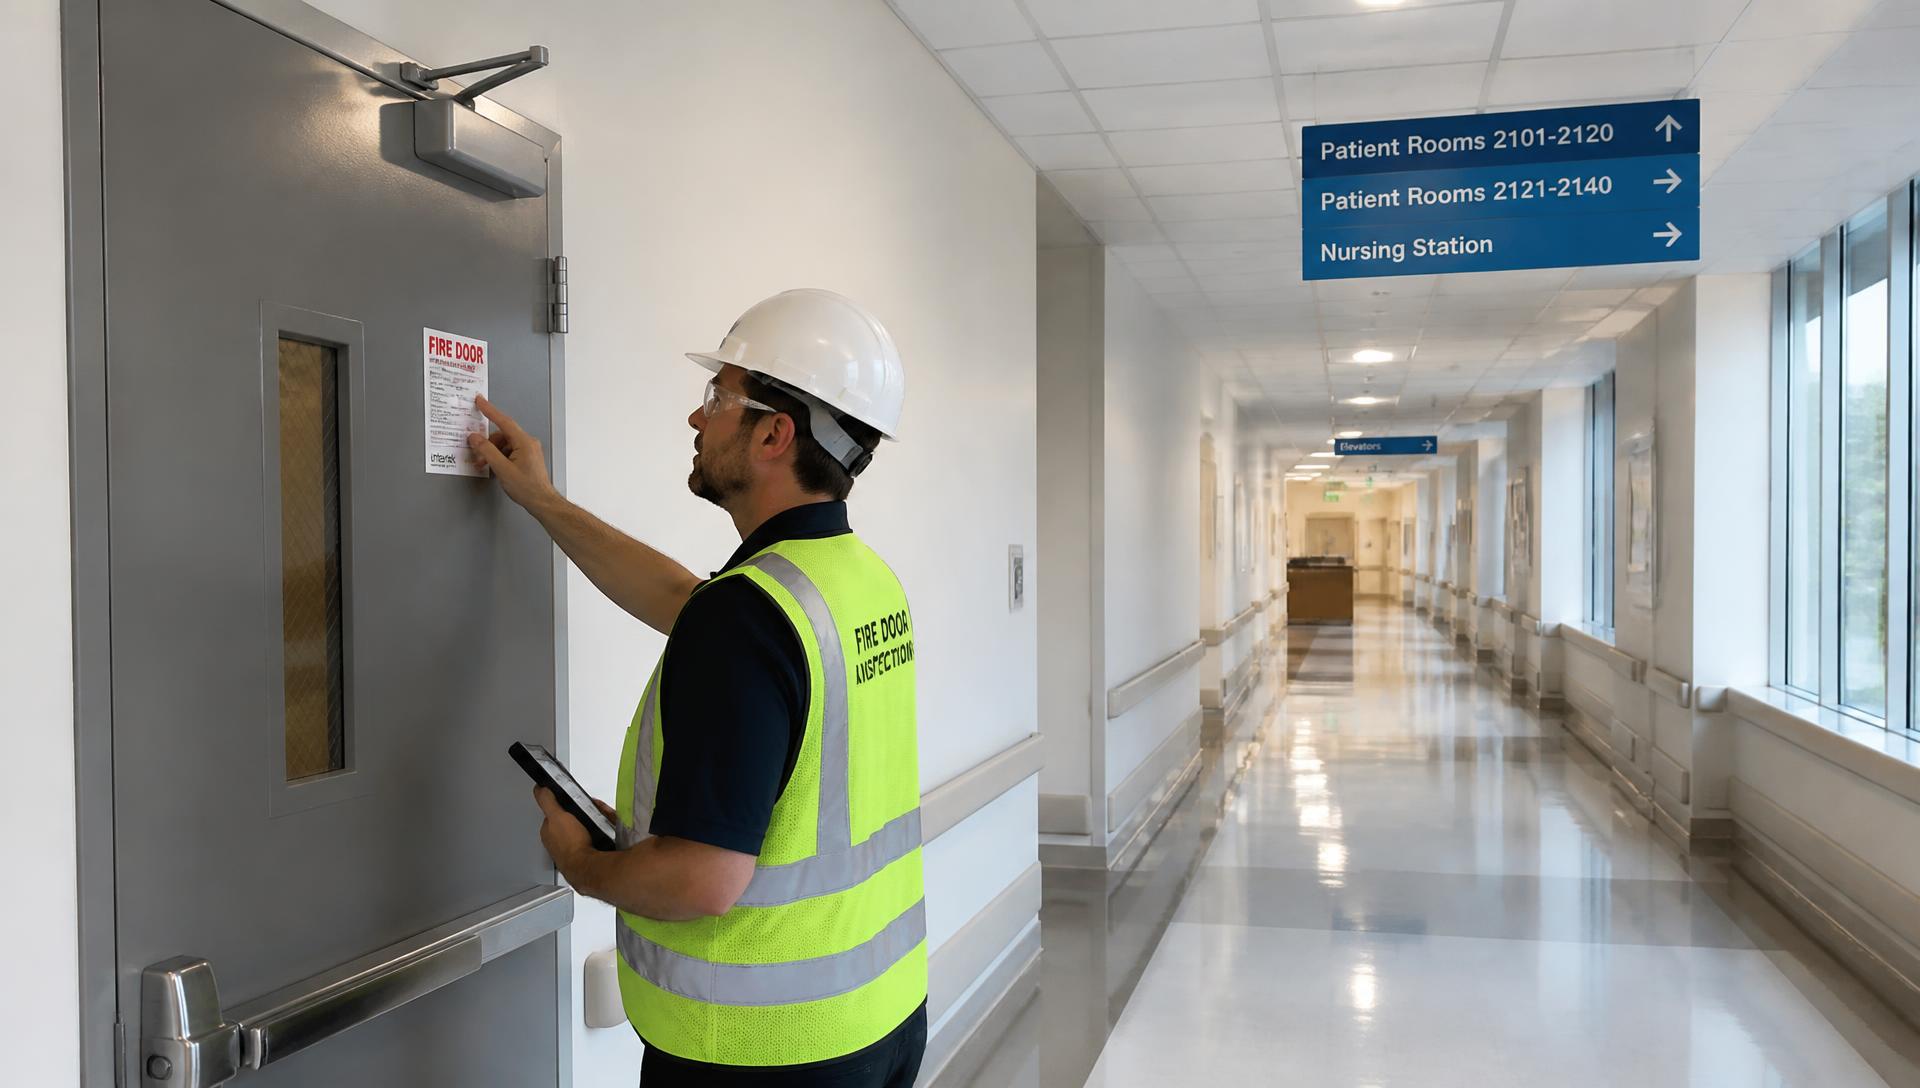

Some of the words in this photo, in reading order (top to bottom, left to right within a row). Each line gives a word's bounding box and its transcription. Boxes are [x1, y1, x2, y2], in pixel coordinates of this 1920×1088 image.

[1321, 139, 1400, 161] Patient
[1407, 134, 1486, 155] Rooms
[1493, 123, 1614, 150] 2101-2120
[1321, 189, 1400, 211] Patient
[1407, 185, 1486, 206] Rooms
[1493, 175, 1613, 201] 2121-2140
[1321, 240, 1405, 263] Nursing
[1412, 235, 1493, 257] Station
[428, 335, 453, 358] FIRE
[455, 341, 484, 364] DOOR
[854, 620, 879, 655] FIRE
[880, 609, 909, 643] DOOR
